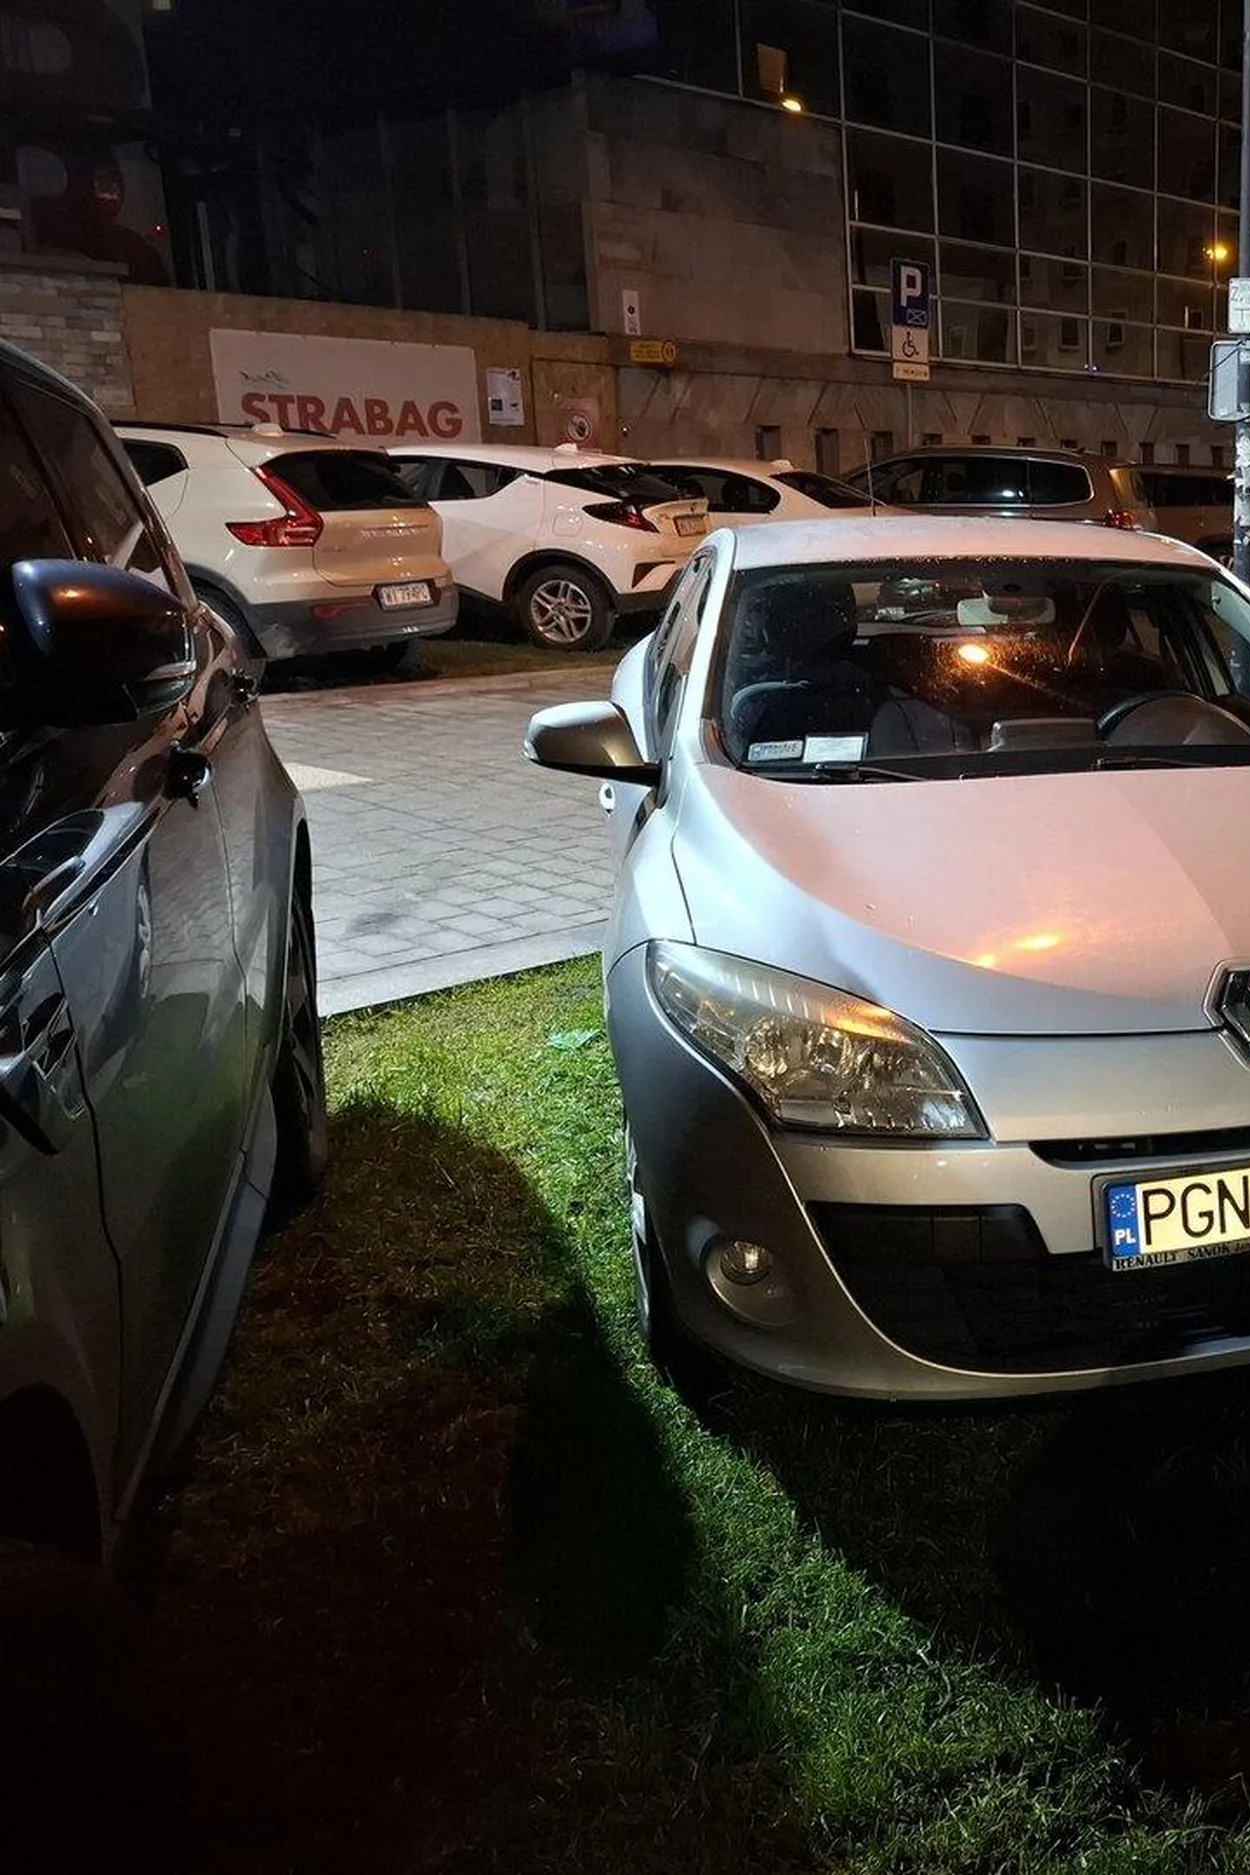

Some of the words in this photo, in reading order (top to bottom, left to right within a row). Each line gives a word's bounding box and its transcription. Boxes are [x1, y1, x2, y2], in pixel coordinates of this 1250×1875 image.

[900, 265, 922, 307] P
[240, 392, 463, 439] STRABAG
[1142, 1174, 1250, 1246] PGN
[1114, 1227, 1137, 1246] PL
[1113, 1250, 1178, 1271] RENAULT
